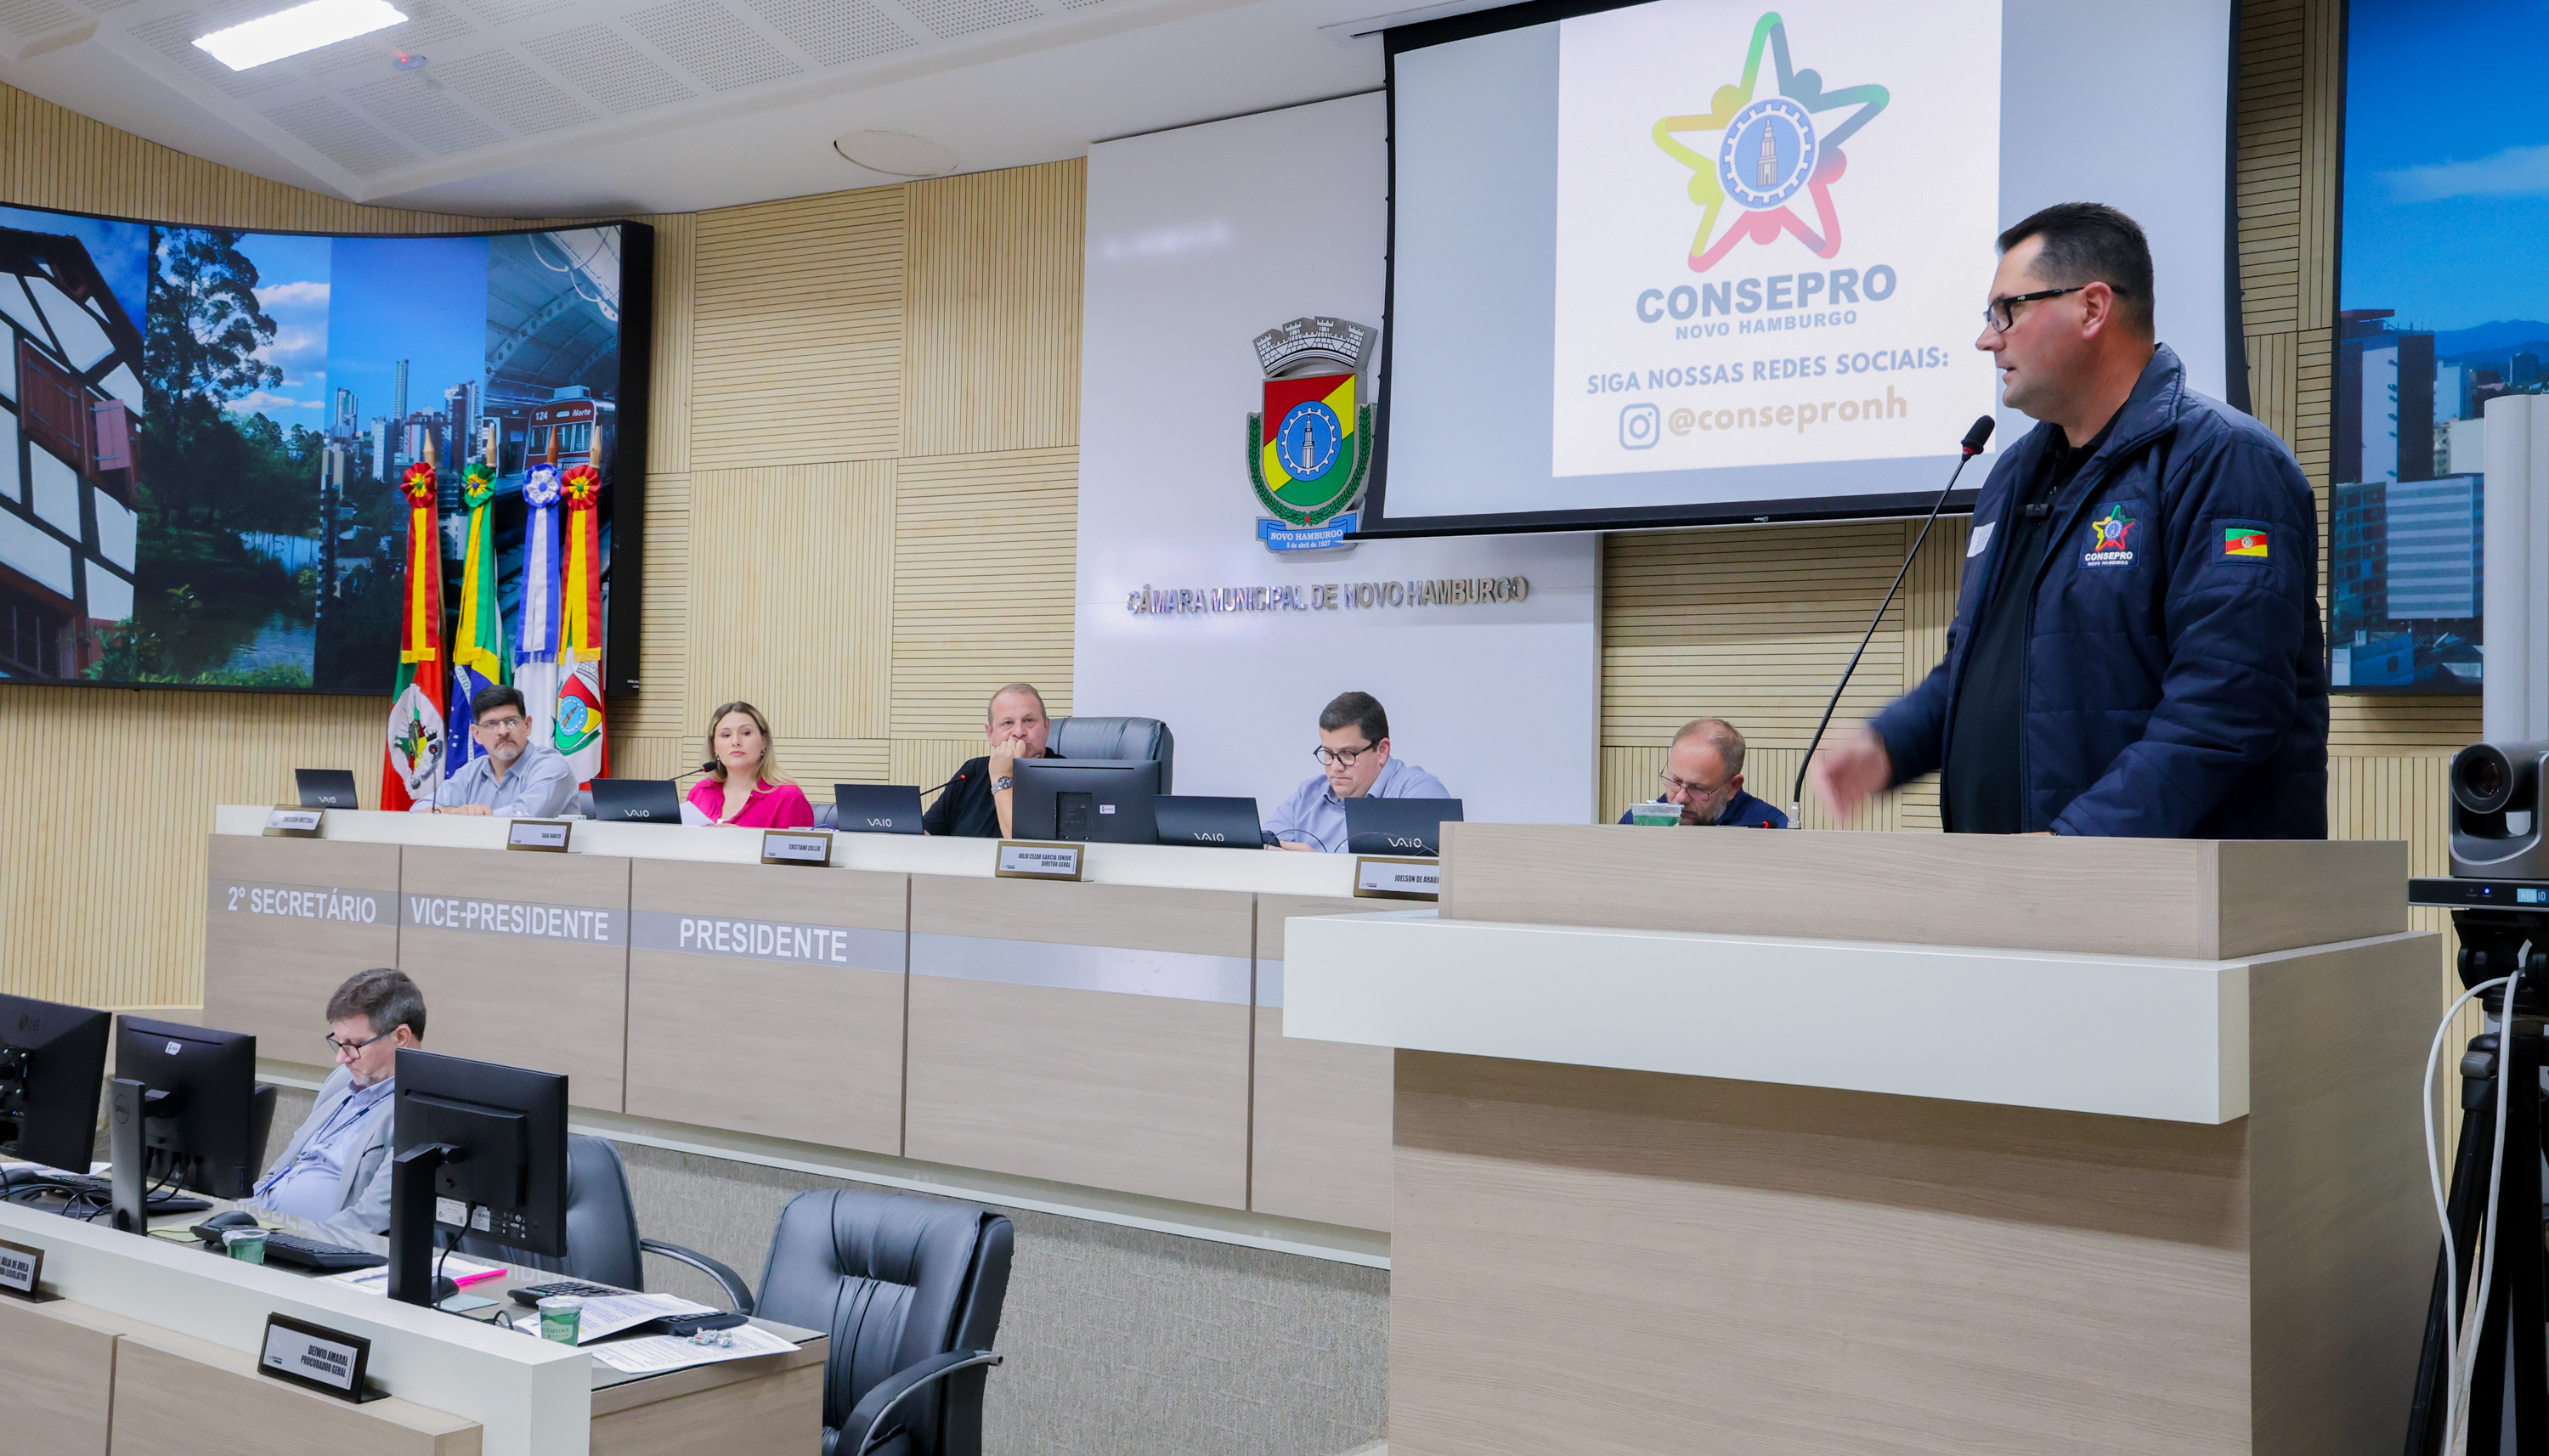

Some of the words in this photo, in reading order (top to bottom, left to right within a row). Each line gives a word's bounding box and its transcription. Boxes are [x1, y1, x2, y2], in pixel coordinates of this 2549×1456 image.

[1636, 264, 1897, 323] CONSEPRO
[1676, 322, 1730, 340] NOVO
[1739, 310, 1857, 334] HAMBURGO
[1586, 371, 1641, 394] SIGA
[1648, 363, 1744, 390] NOSSAS
[1752, 355, 1827, 381] REDES
[1835, 347, 1949, 375] SOCIAIS:
[535, 411, 548, 420] 124
[572, 409, 591, 417] Norte
[1668, 385, 1908, 437] @consepronh
[1270, 532, 1293, 540] NOVO
[1296, 529, 1342, 540] HAMBURGO
[2084, 551, 2134, 562] CONSEPRO
[1126, 584, 1207, 614] CÂMARA
[1211, 585, 1307, 612] MUNICIPAL
[1311, 584, 1338, 610] DE
[1343, 580, 1403, 609] NOVO
[1407, 576, 1529, 607] HAMBURGO
[624, 809, 650, 817] VAIO
[867, 818, 892, 827] VAIO
[1194, 832, 1224, 842] VAIO
[1388, 838, 1422, 848] VAIO
[1394, 874, 1416, 883] JOELSON
[1423, 875, 1439, 883] ARAÚJ
[228, 886, 246, 911] 2º
[251, 888, 376, 923] SECRETÁRIO
[411, 896, 609, 941] VICE-PRESIDENTE
[680, 918, 848, 962] PRESIDENTE
[300, 1355, 332, 1373] PROCURADOR
[331, 1364, 346, 1377] GERAL
[327, 1351, 348, 1367] AMARAL
